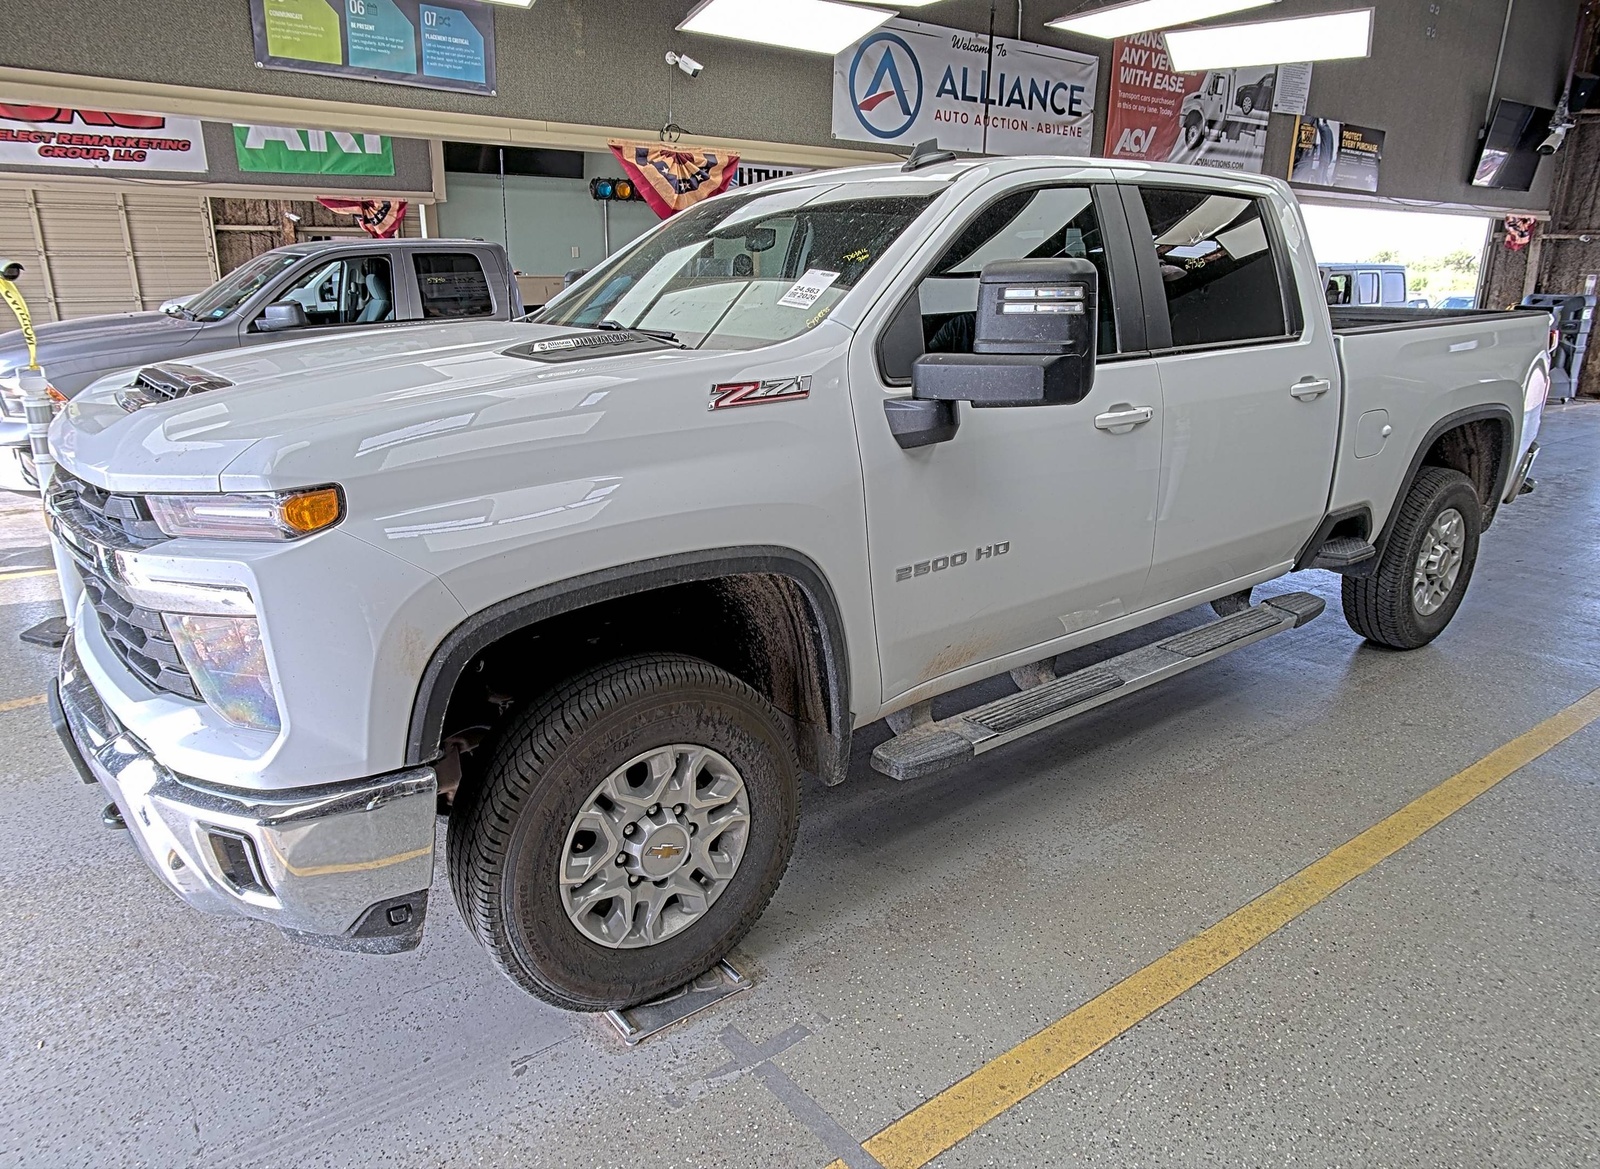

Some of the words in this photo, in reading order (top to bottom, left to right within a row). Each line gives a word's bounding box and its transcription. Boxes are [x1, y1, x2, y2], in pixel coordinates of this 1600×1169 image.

[349, 0, 365, 15] 06
[356, 23, 375, 31] PRESENT
[424, 10, 437, 27] 07
[425, 33, 448, 42] PLACEMENT
[452, 37, 470, 46] CRITICAL
[1123, 31, 1167, 51] RANS
[995, 43, 1007, 57] To
[1120, 46, 1150, 67] ANY
[1120, 66, 1153, 88] WITH
[1152, 72, 1185, 93] EASE.
[935, 64, 1085, 117] ALLIANCE
[1118, 90, 1140, 101] Transport
[1140, 95, 1151, 103] cars
[1151, 96, 1175, 106] purchased
[1117, 101, 1122, 109] in
[1122, 102, 1132, 110] this
[1138, 105, 1147, 114] any
[1147, 105, 1159, 114] lane.
[1159, 107, 1174, 118] Today.
[934, 109, 969, 124] AUTO
[974, 114, 1028, 132] AUCTION
[1036, 122, 1082, 138] ABILENE
[57, 132, 192, 151] REMARKETING
[1112, 126, 1157, 155] ACV
[1341, 139, 1356, 149] EVERY
[1342, 130, 1363, 142] PROTECT
[38, 145, 110, 162] GROUP,
[112, 150, 147, 163] LLC
[739, 167, 793, 187] LITH
[573, 332, 634, 348] DURAMAX
[707, 374, 812, 411] Z71
[896, 551, 968, 582] 2500
[975, 540, 1010, 561] HD
